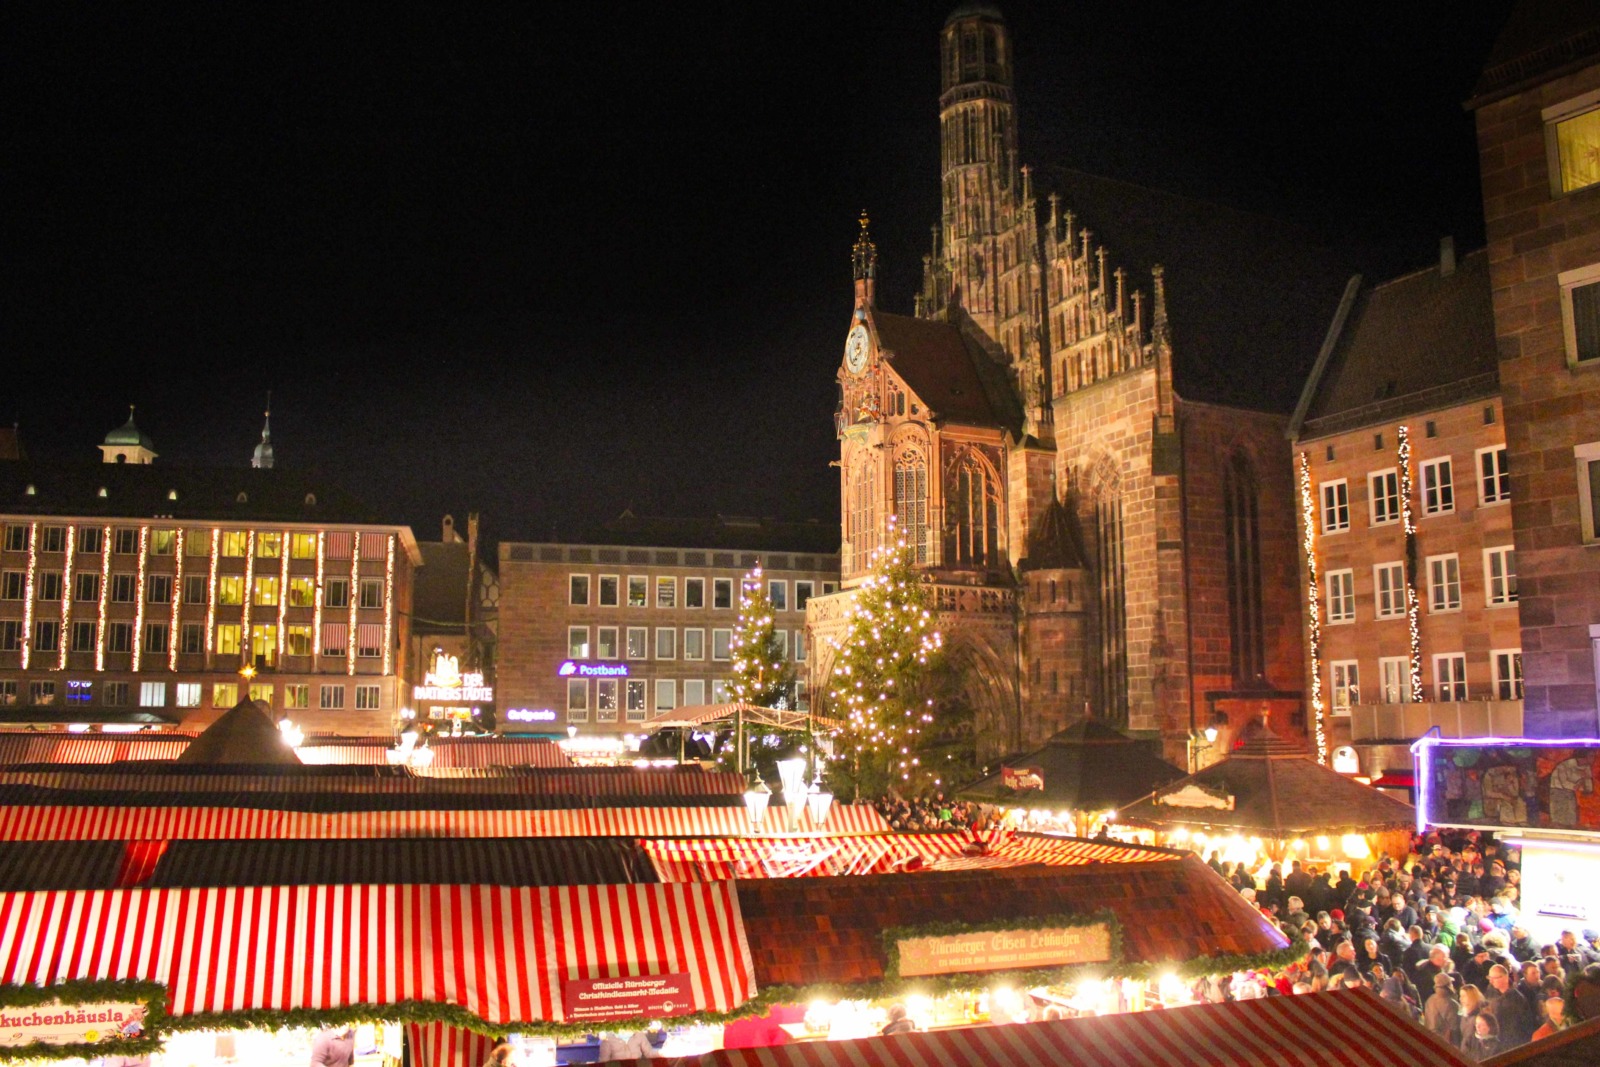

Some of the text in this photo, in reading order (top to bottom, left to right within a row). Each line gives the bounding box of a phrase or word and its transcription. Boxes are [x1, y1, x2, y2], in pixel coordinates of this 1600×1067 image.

[579, 664, 628, 676] Postbank
[463, 673, 484, 687] DER
[928, 931, 1081, 955] Nürnberger Elisen Lebkuchen
[592, 979, 666, 990] Offizielle Nürnberger
[0, 1008, 124, 1028] kuchenhäusla
